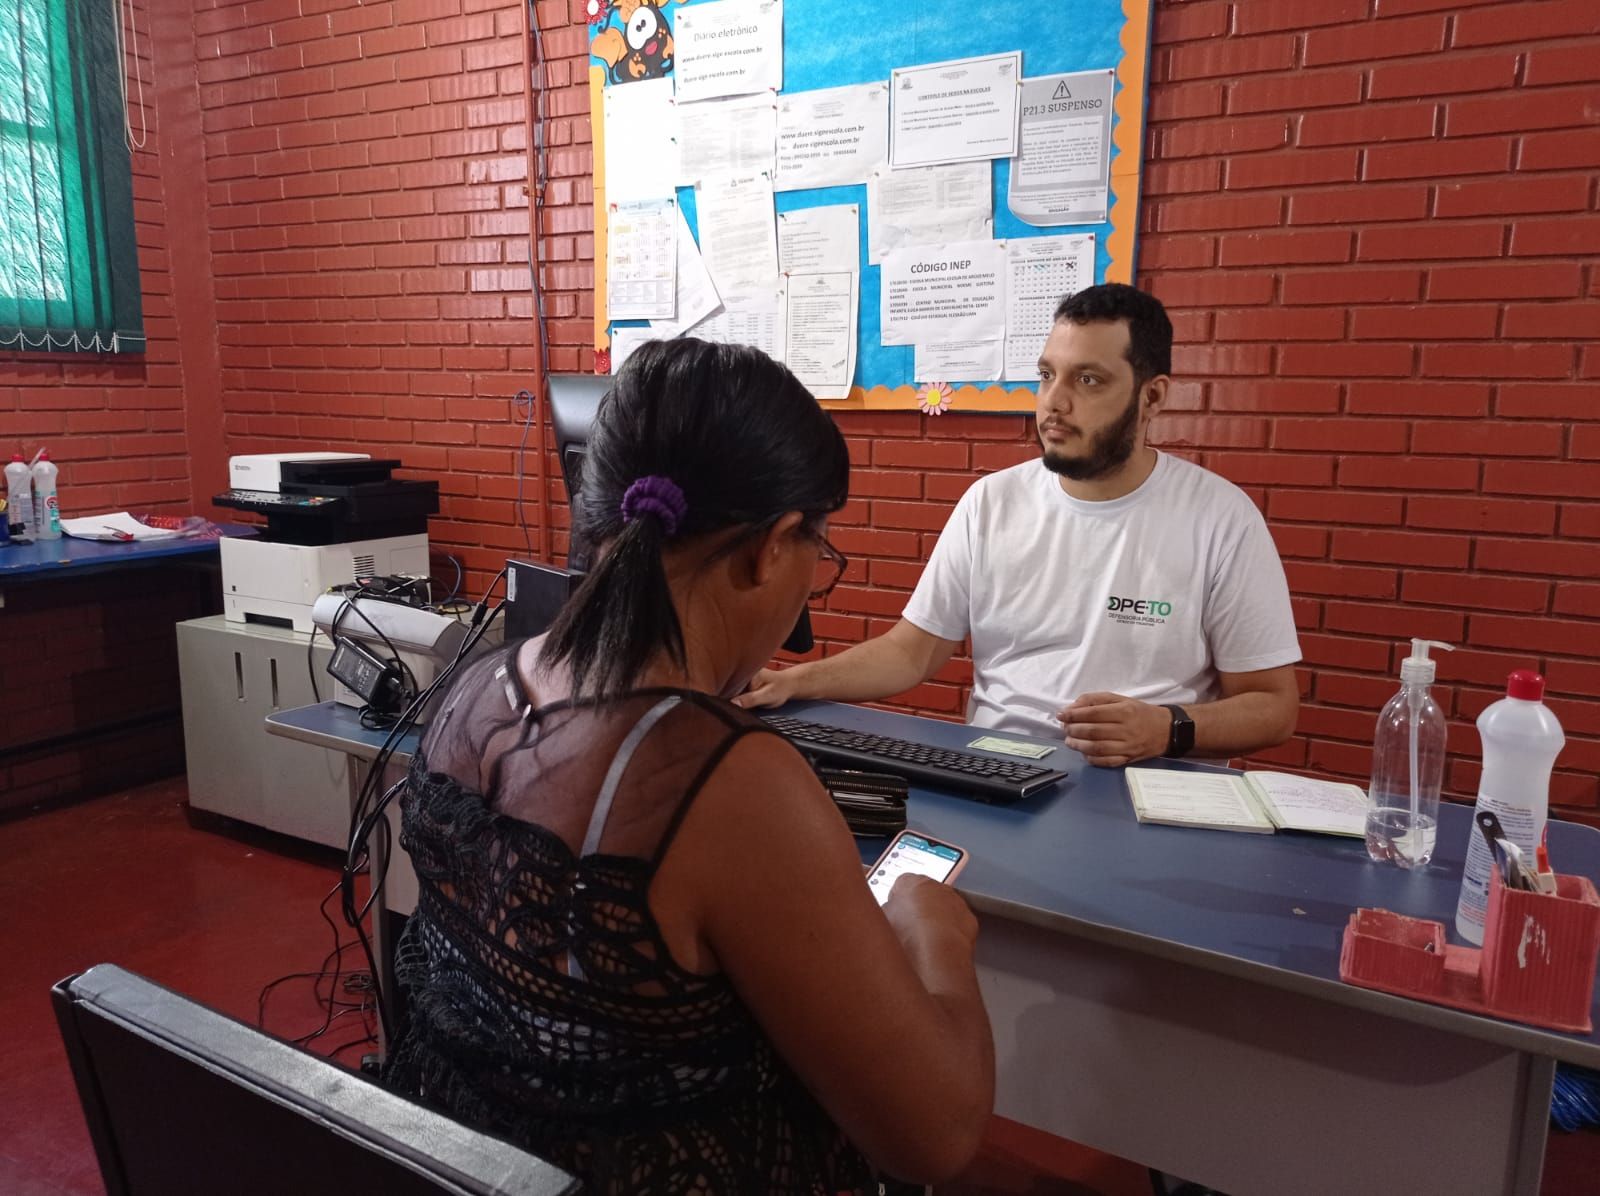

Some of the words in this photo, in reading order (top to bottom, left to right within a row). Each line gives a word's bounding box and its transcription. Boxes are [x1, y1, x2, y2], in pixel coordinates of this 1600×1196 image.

[718, 24, 758, 38] eletrônico
[1023, 104, 1046, 116] P21.3
[1048, 98, 1103, 113] SUSPENSO
[910, 262, 948, 274] CÓDIGO
[950, 260, 971, 271] INEP
[1108, 612, 1141, 621] DEFENSORIA
[1141, 616, 1166, 624] PÚBLICA
